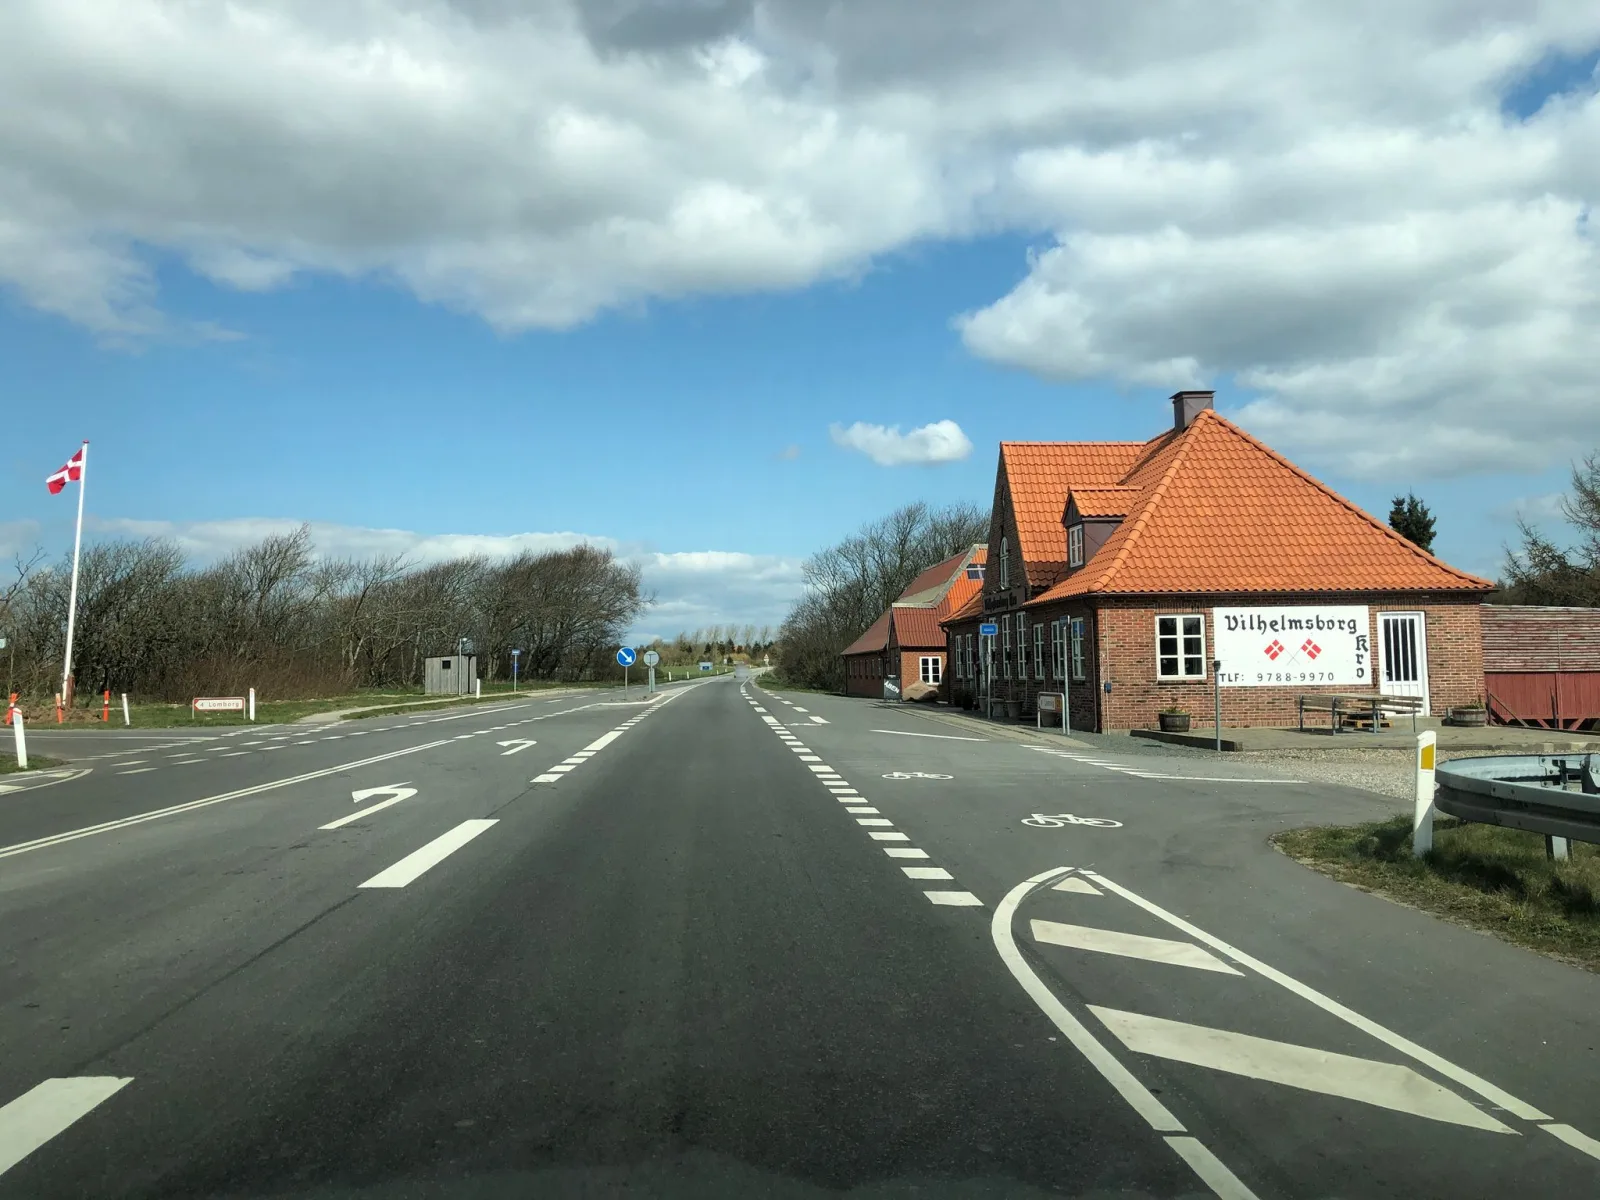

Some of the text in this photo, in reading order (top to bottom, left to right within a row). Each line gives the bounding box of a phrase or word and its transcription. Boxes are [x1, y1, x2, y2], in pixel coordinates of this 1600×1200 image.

[1224, 614, 1357, 635] Vilhelmsborg
[1355, 634, 1369, 679] Kro
[1220, 672, 1335, 682] TLF: 9788-9970
